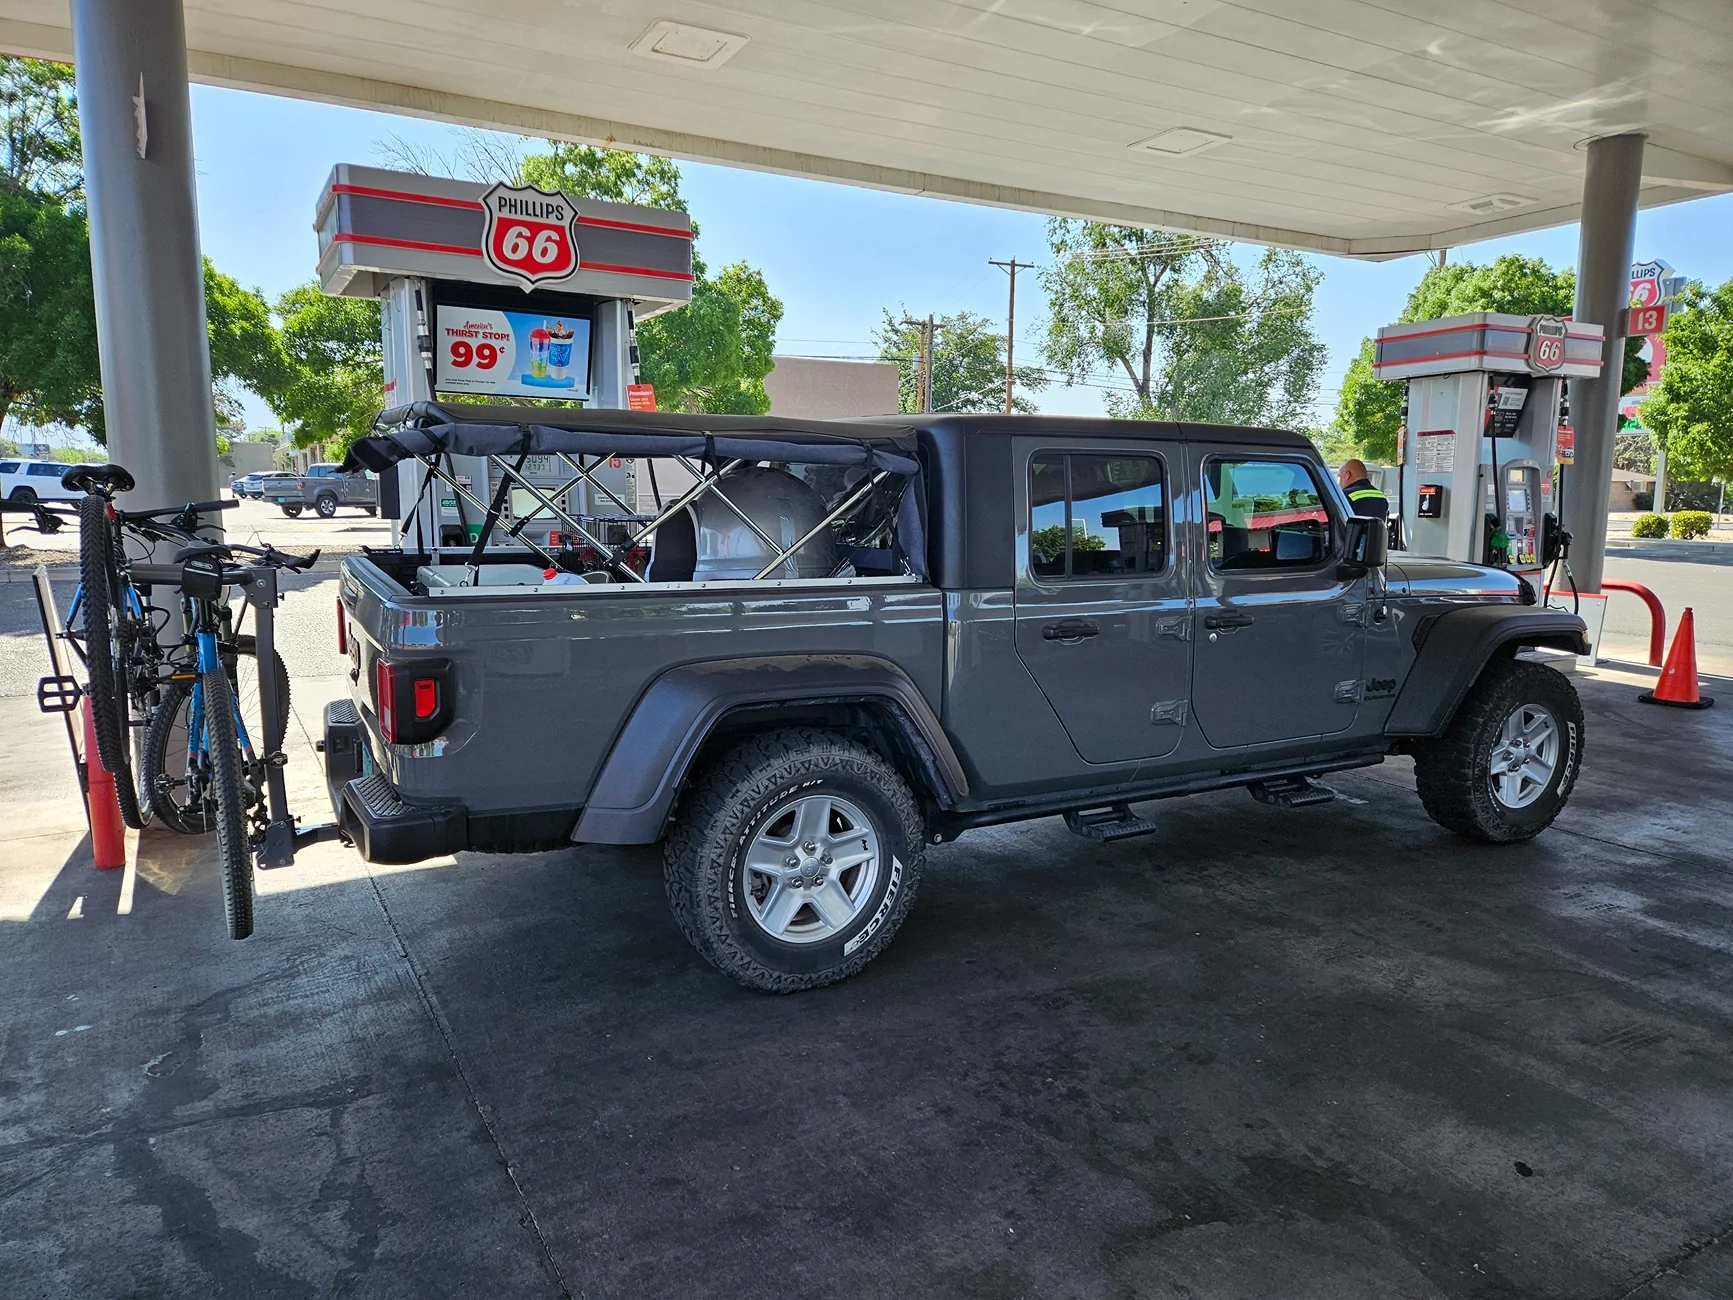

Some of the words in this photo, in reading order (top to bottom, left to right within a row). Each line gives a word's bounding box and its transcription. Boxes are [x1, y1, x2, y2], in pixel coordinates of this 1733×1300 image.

[498, 196, 564, 221] PHILLIPS
[502, 225, 560, 264] 66
[1631, 267, 1656, 280] LLIPS
[1637, 310, 1658, 331] 13
[445, 328, 480, 338] THIRST
[482, 331, 510, 341] STOP!
[1540, 340, 1561, 361] 66
[608, 457, 622, 469] 15
[1366, 677, 1397, 694] Jeep
[739, 784, 799, 847] ATTITUDE
